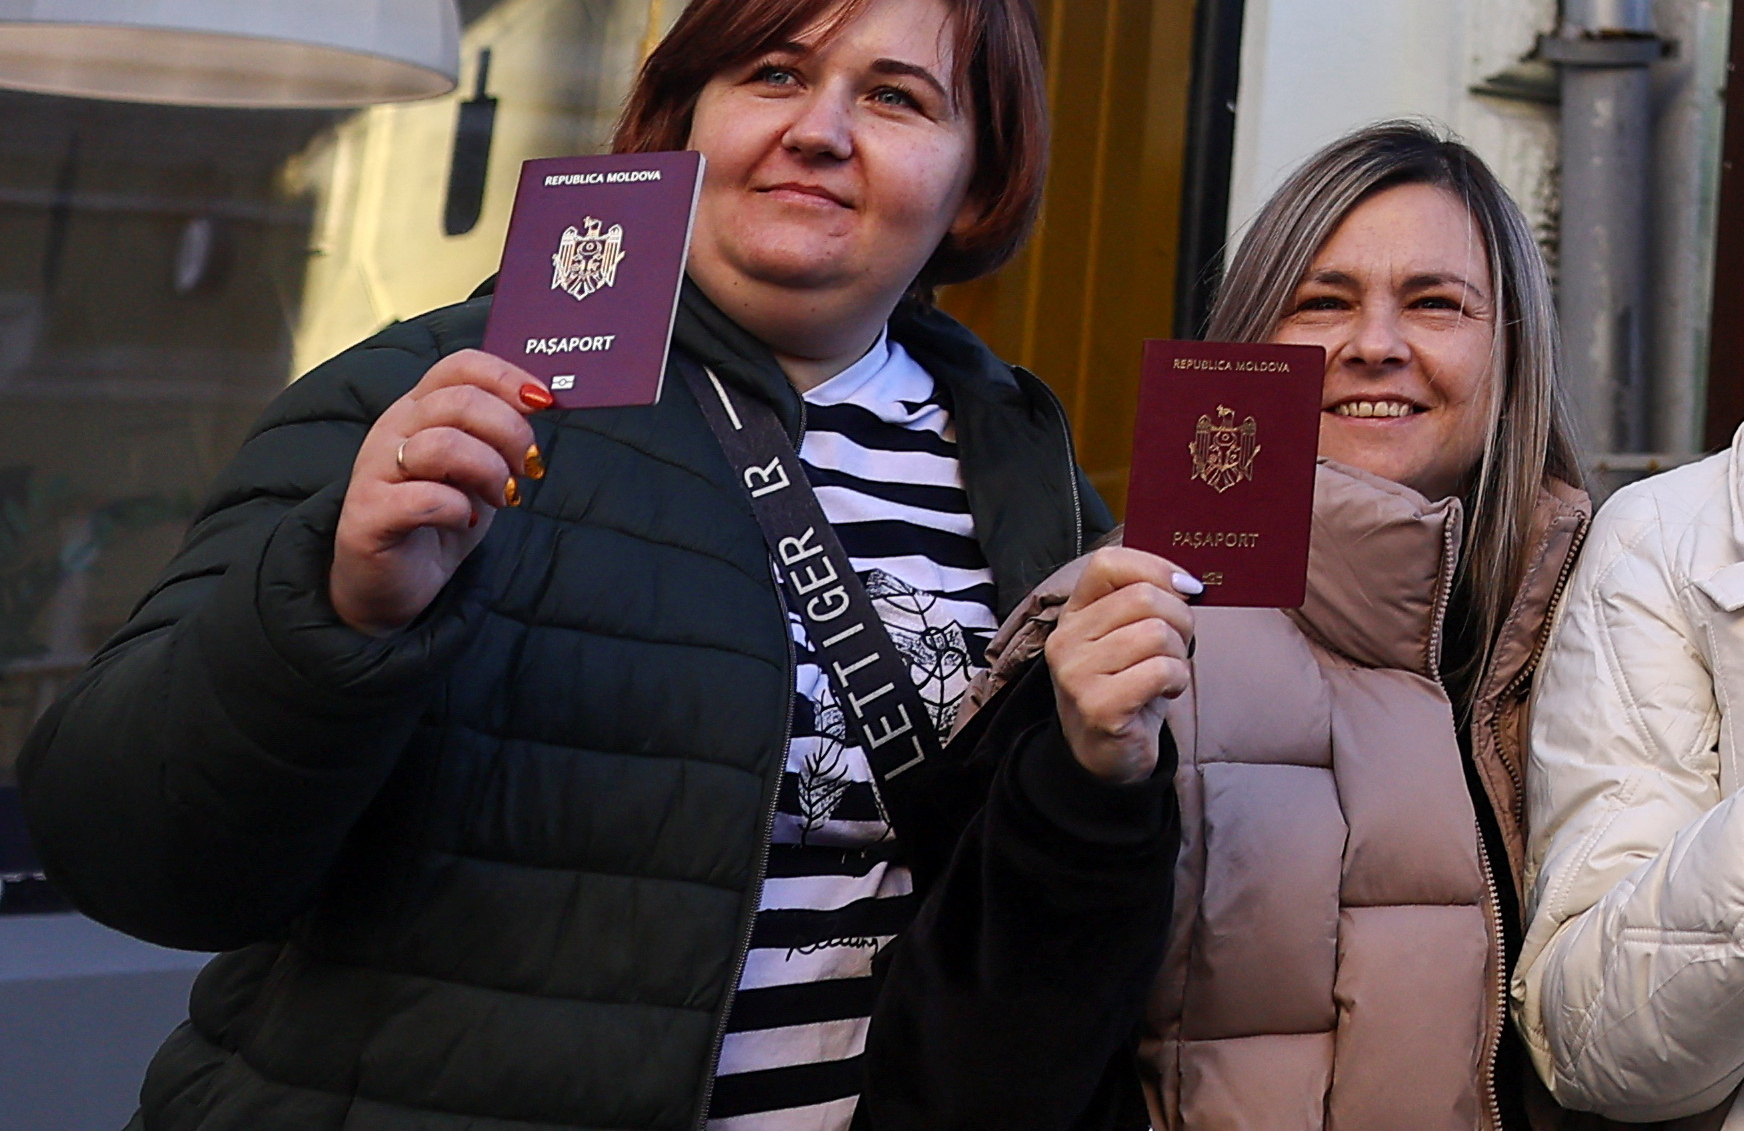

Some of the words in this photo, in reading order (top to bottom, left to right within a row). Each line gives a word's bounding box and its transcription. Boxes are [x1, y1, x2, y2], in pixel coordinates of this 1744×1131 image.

[544, 173, 604, 187] REPUBLICA
[606, 170, 661, 183] MOLDOVA
[1172, 358, 1233, 371] REPUBLICA
[1235, 360, 1290, 373] MOLDOVA
